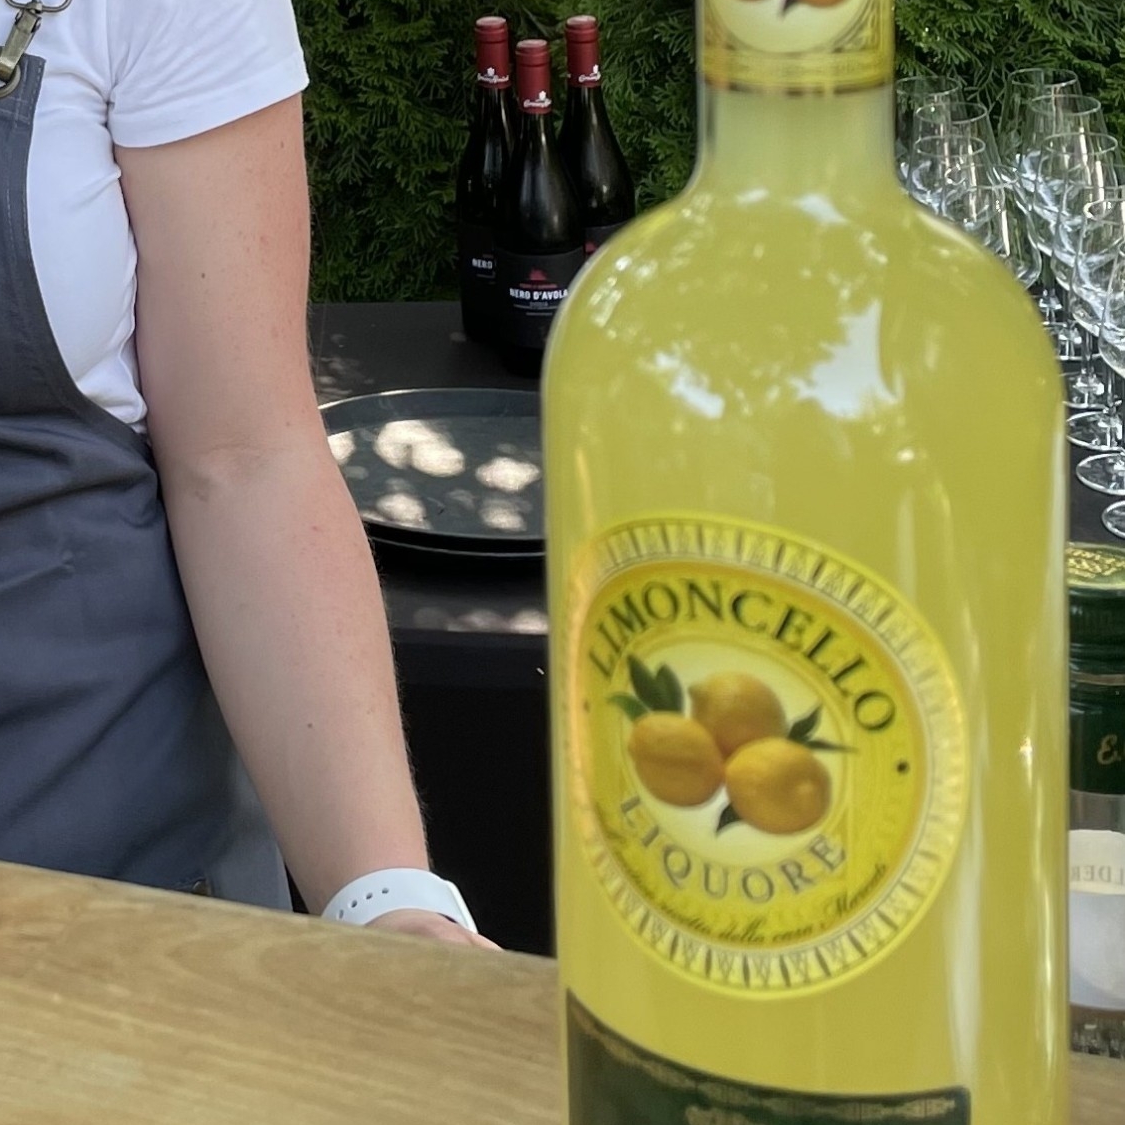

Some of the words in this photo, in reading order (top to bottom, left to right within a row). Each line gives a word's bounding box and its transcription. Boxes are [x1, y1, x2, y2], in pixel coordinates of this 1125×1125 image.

[510, 288, 531, 300] NERO
[589, 578, 895, 732] LIMONCELLO
[620, 794, 846, 904] LIQUORE
